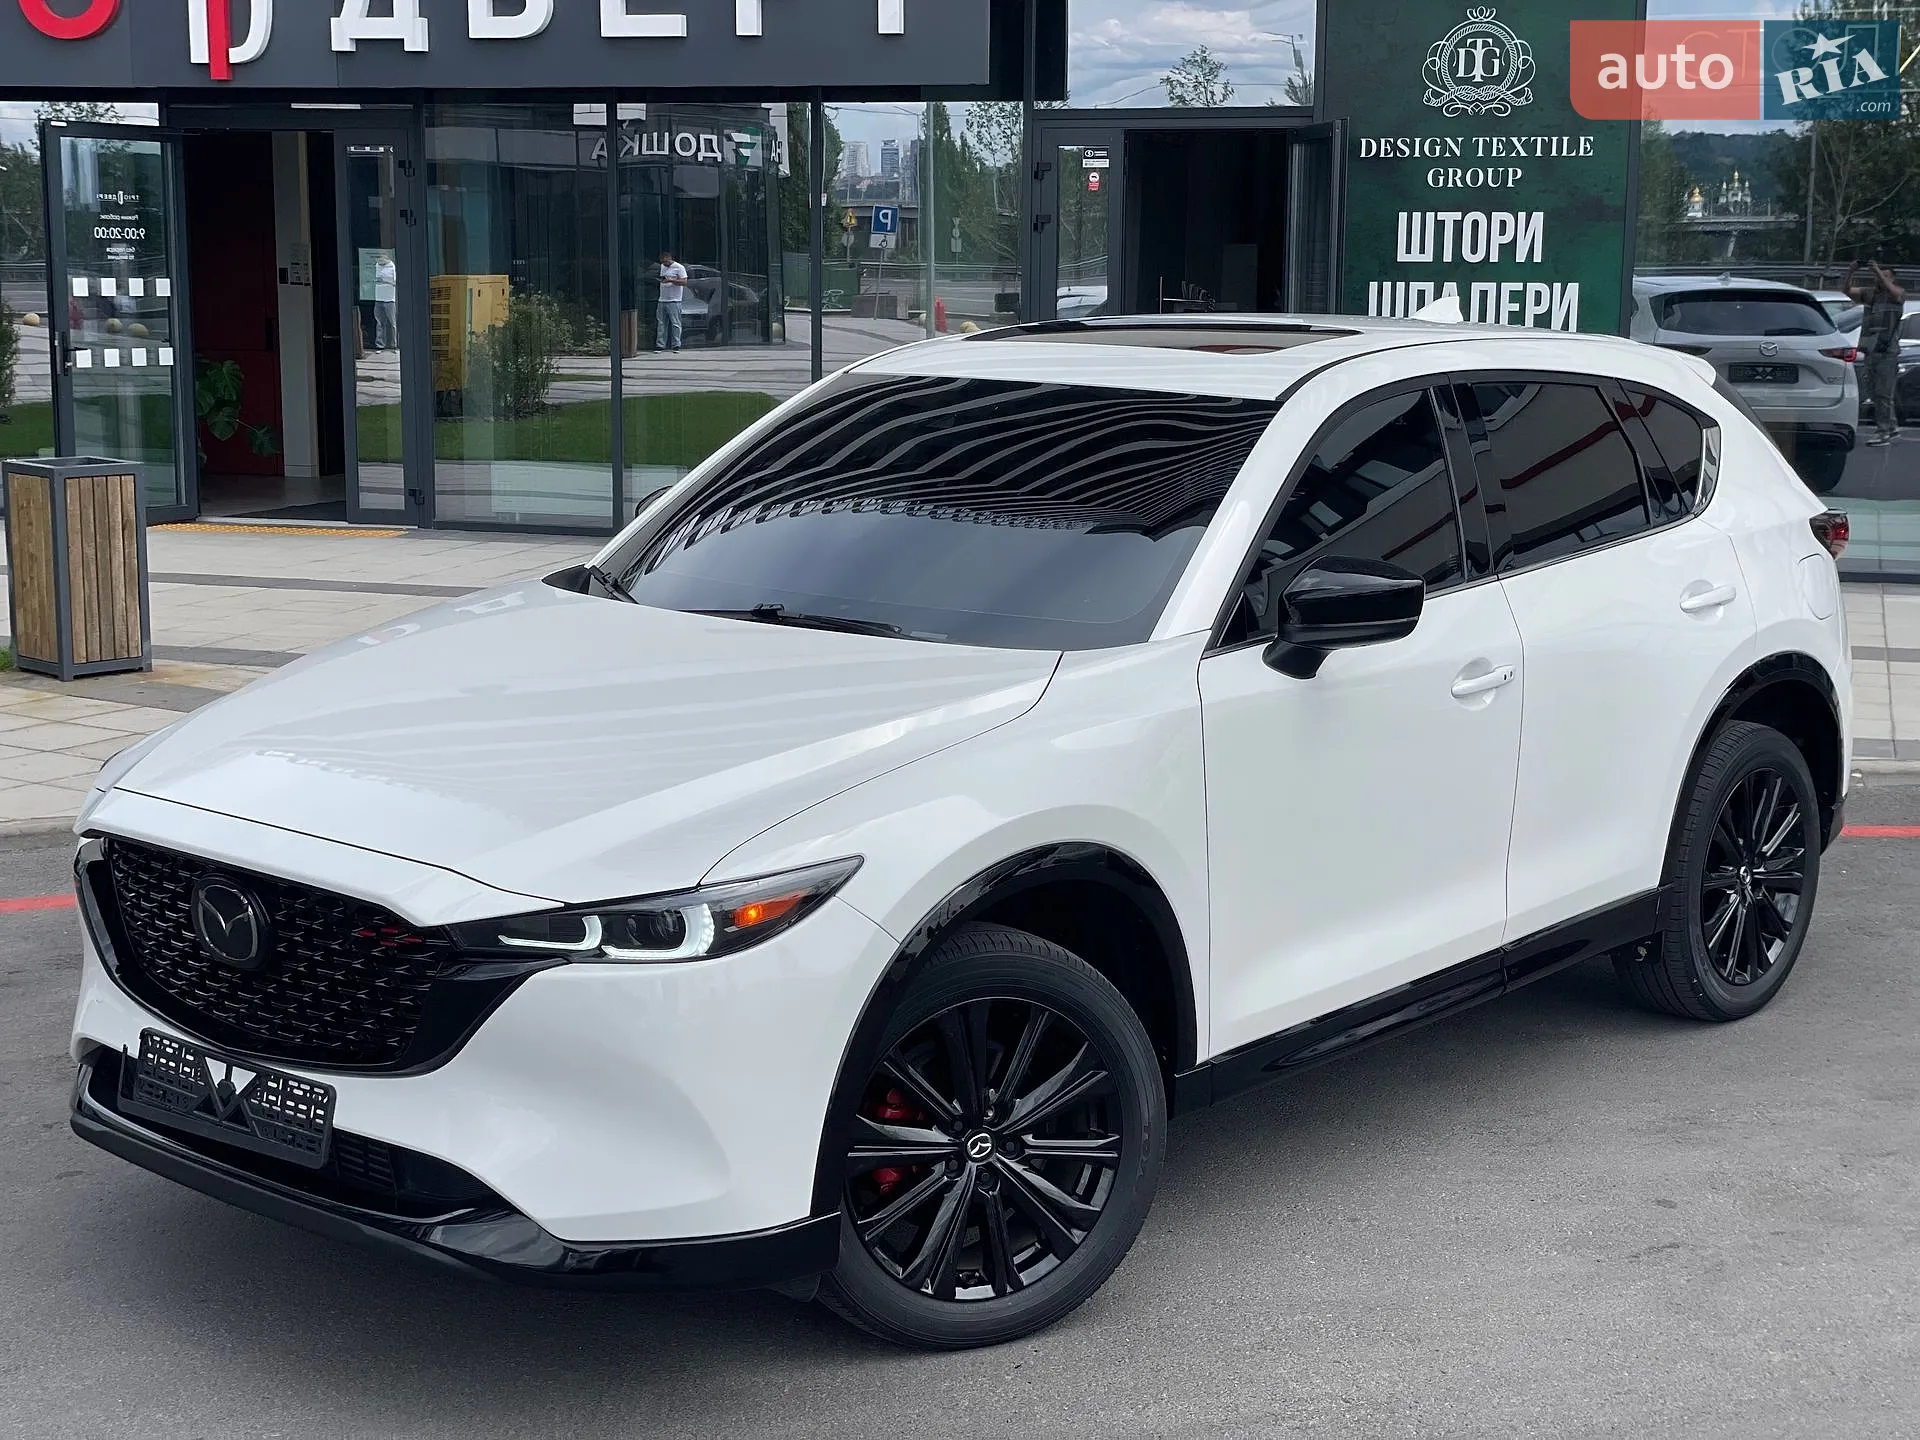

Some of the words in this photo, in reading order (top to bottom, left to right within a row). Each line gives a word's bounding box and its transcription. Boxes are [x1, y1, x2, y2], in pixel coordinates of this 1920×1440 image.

[1359, 137, 1464, 158] DESIGN
[1472, 136, 1594, 157] TEXTILE
[1427, 167, 1522, 188] GROUP
[1396, 211, 1544, 263] ШТОРИ
[1368, 281, 1579, 333] ШПЛЕРИ
